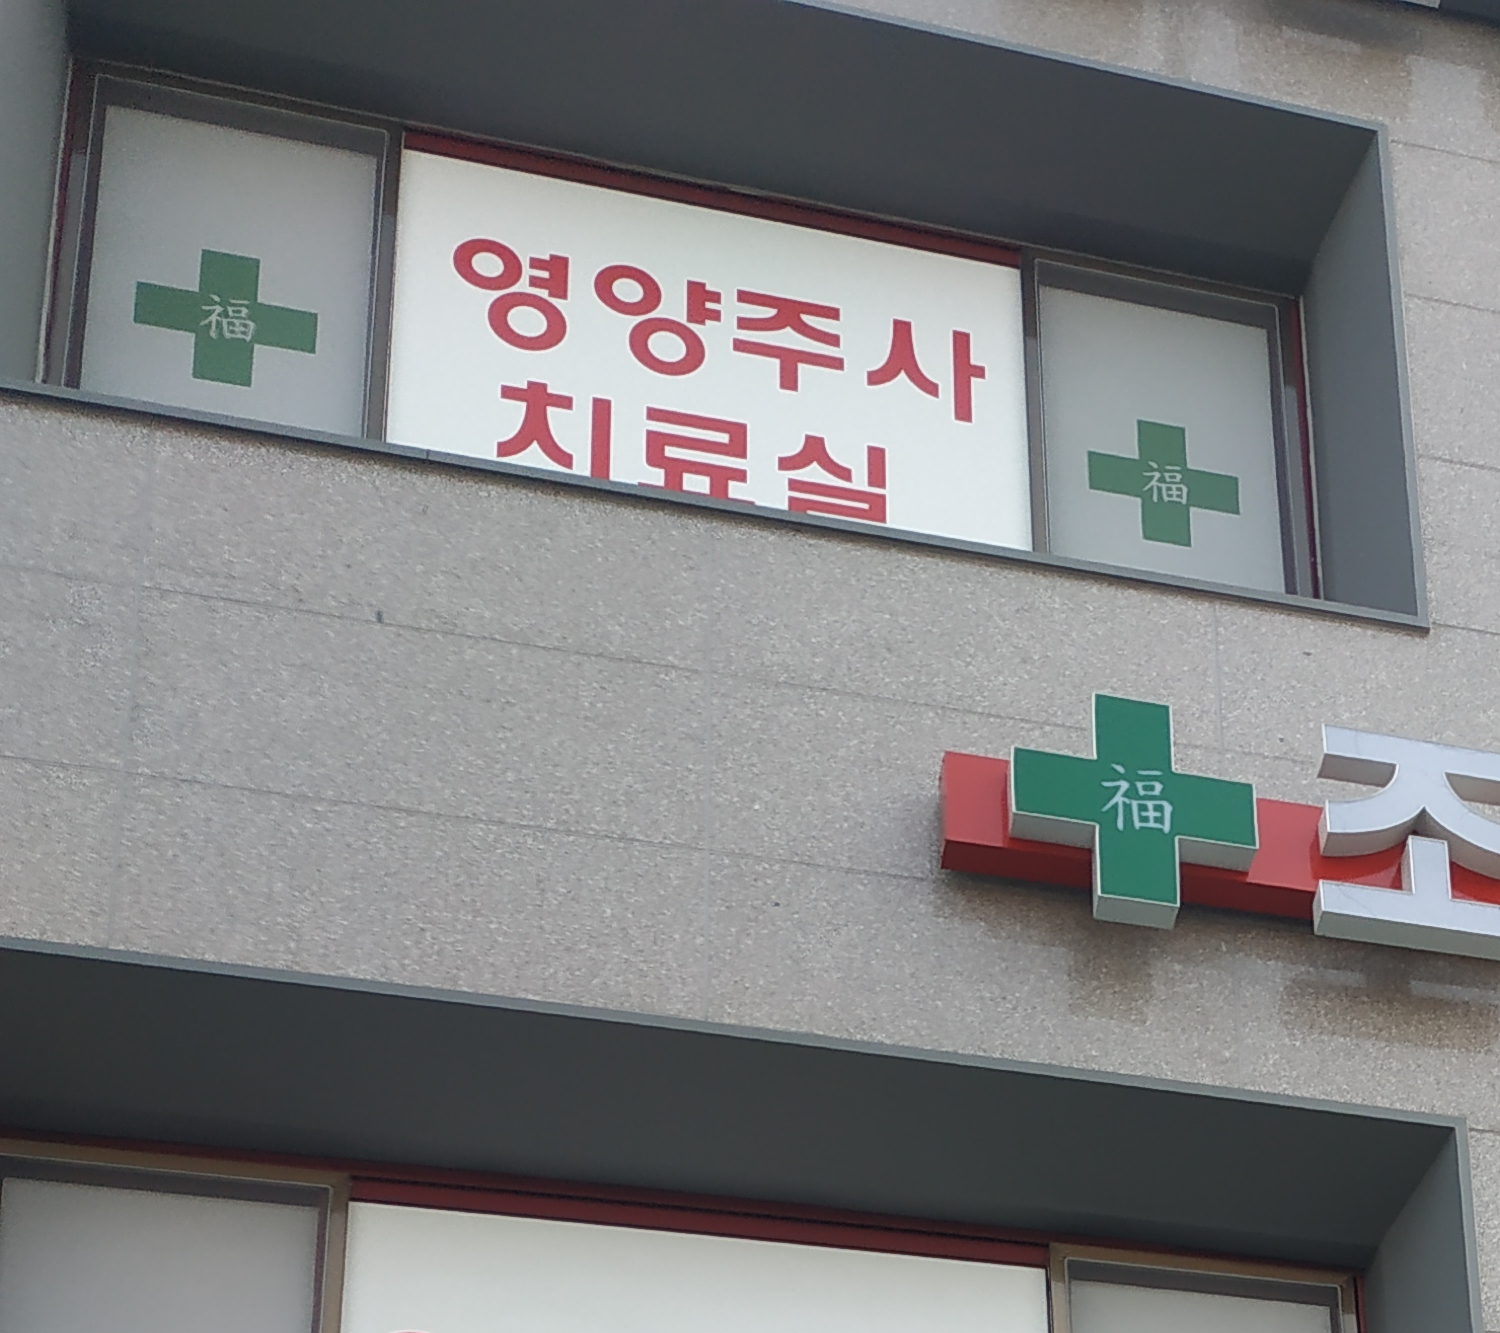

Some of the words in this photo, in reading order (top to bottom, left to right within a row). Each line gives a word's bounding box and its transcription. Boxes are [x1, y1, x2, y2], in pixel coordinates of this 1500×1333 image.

[201, 292, 254, 343] 福
[452, 237, 986, 424] 영양주사
[496, 380, 888, 525] 치료실
[1142, 459, 1188, 507] 福
[1101, 763, 1173, 835] 福
